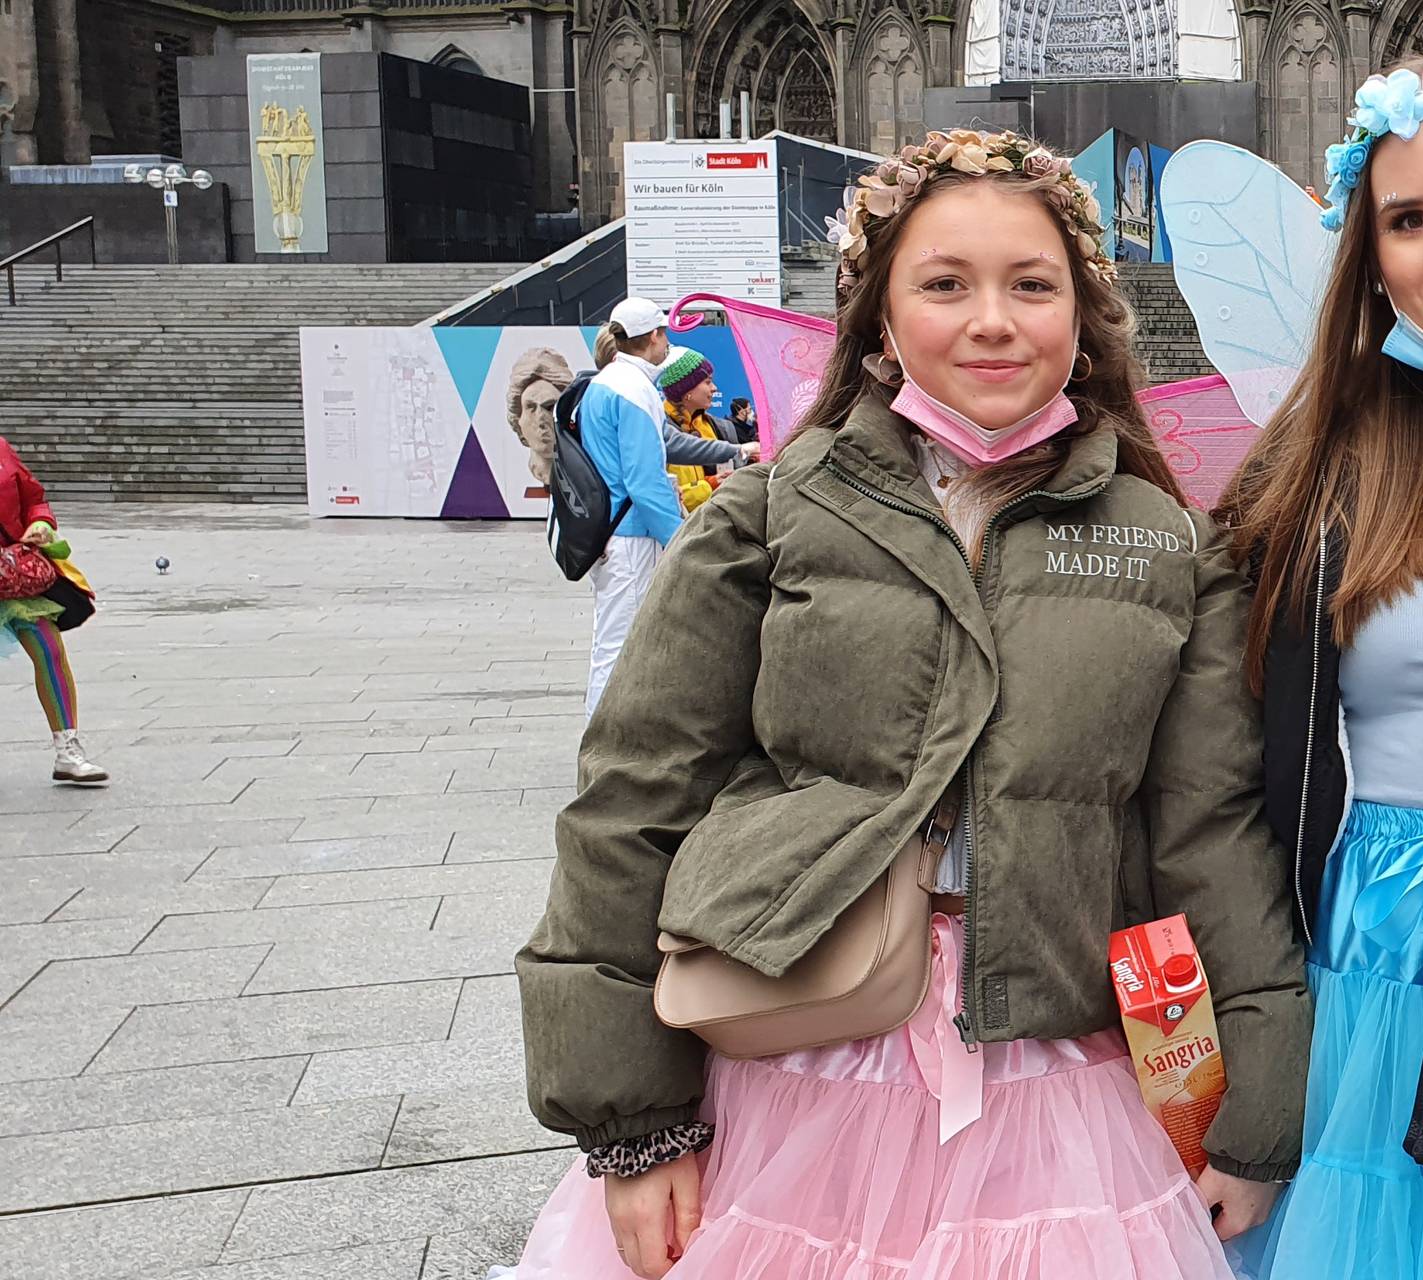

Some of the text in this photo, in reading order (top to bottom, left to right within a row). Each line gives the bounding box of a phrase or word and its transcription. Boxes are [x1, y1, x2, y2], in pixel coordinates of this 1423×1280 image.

[709, 157, 741, 166] Stadt Köln
[633, 183, 724, 193] Wir bauen für Köln
[1046, 524, 1085, 543] MY
[1044, 550, 1151, 581] MADE IT
[1110, 956, 1145, 992] Sangria
[1143, 1036, 1215, 1077] Sangria
